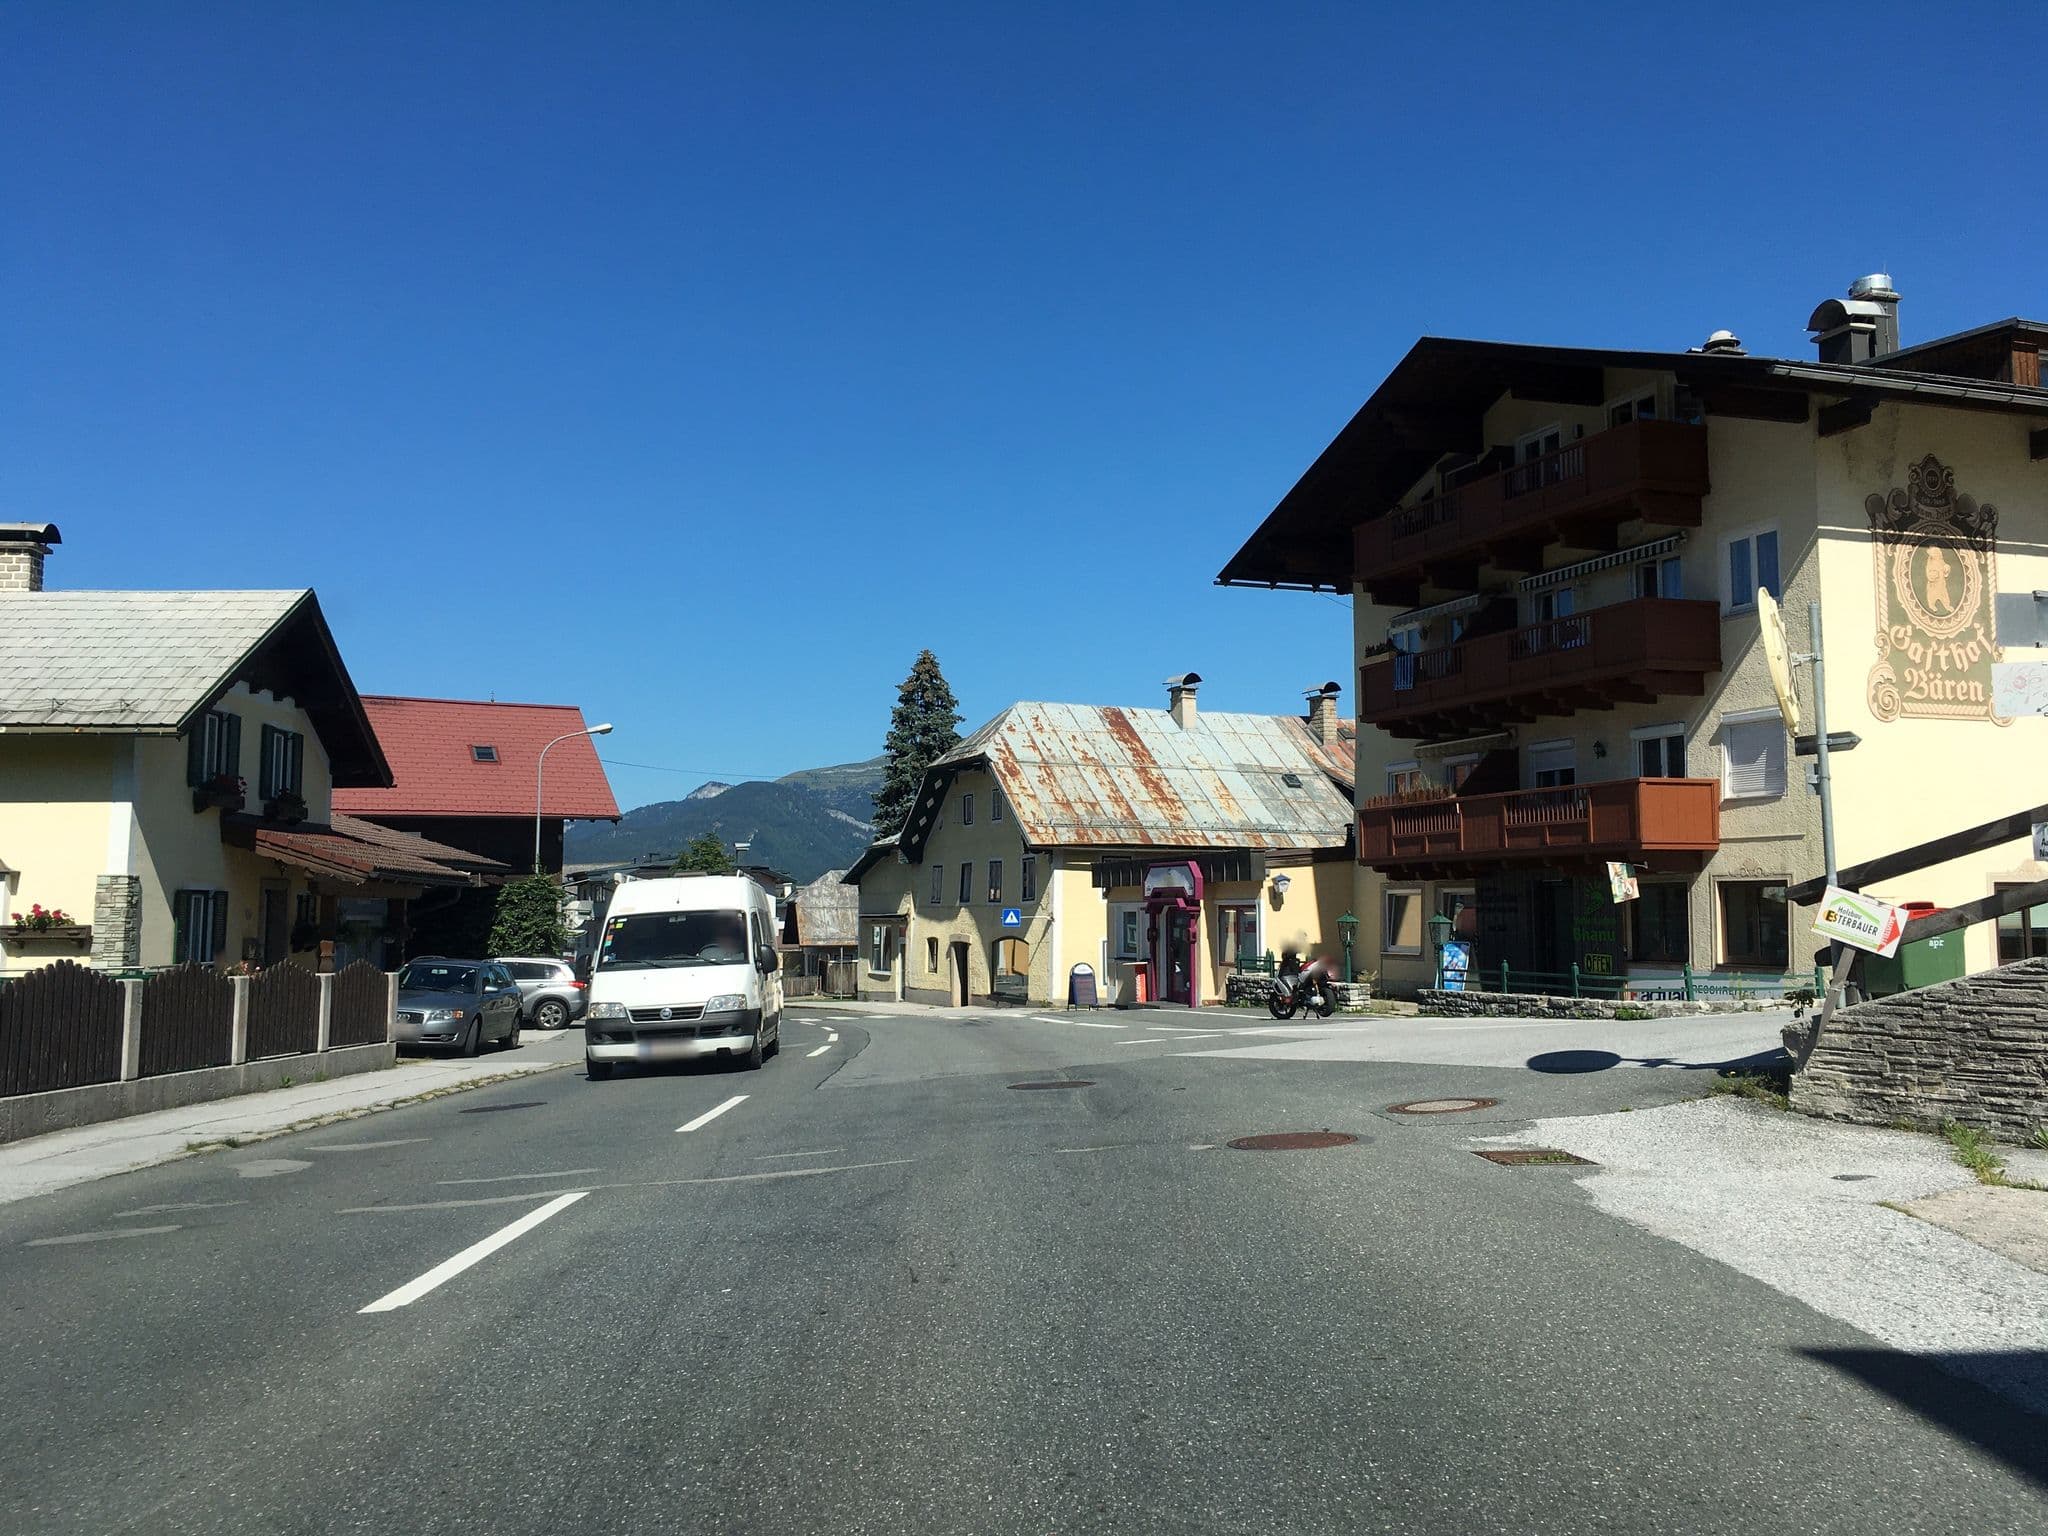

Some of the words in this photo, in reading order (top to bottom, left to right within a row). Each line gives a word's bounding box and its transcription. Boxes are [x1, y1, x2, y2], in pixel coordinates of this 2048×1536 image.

[1890, 622, 1992, 672] Gasthof
[1904, 668, 1985, 702] Bären
[1825, 909, 1879, 936] ESTERBAUER
[1837, 906, 1863, 920] Holzbau
